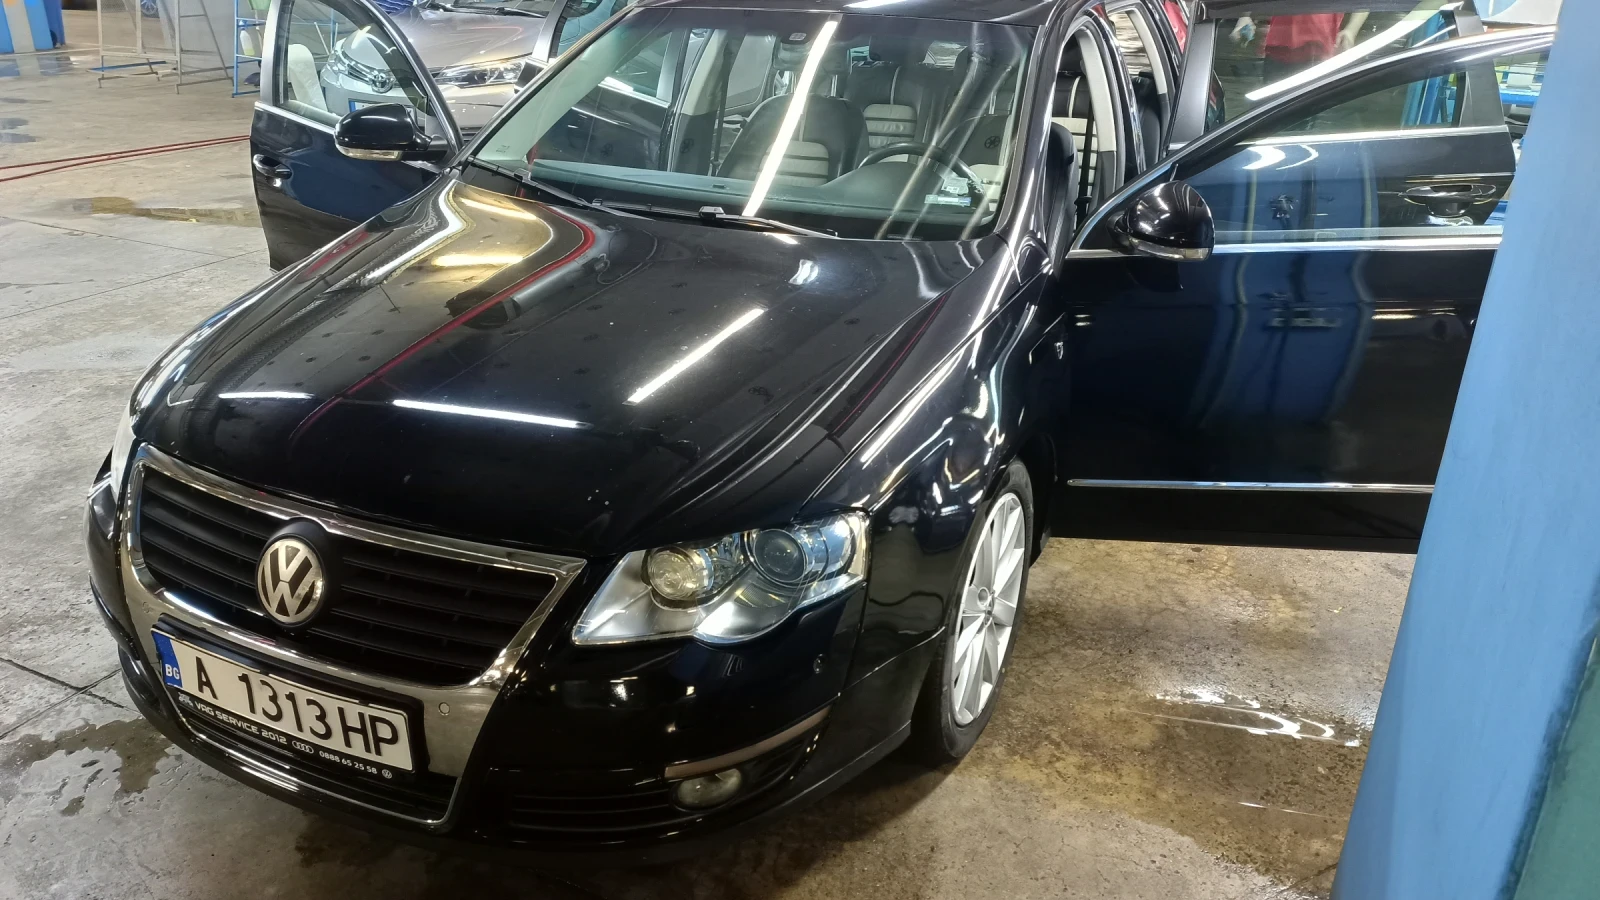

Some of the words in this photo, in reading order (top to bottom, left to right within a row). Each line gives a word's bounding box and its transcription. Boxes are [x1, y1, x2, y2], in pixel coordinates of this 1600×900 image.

[165, 664, 180, 680] BG
[195, 655, 218, 701] A
[238, 672, 333, 741] 1313
[337, 706, 399, 757] HP
[215, 711, 260, 735] SERVICE
[261, 729, 288, 745] 2012
[319, 750, 340, 763] 0888
[341, 758, 353, 767] 65
[353, 761, 365, 771] 25
